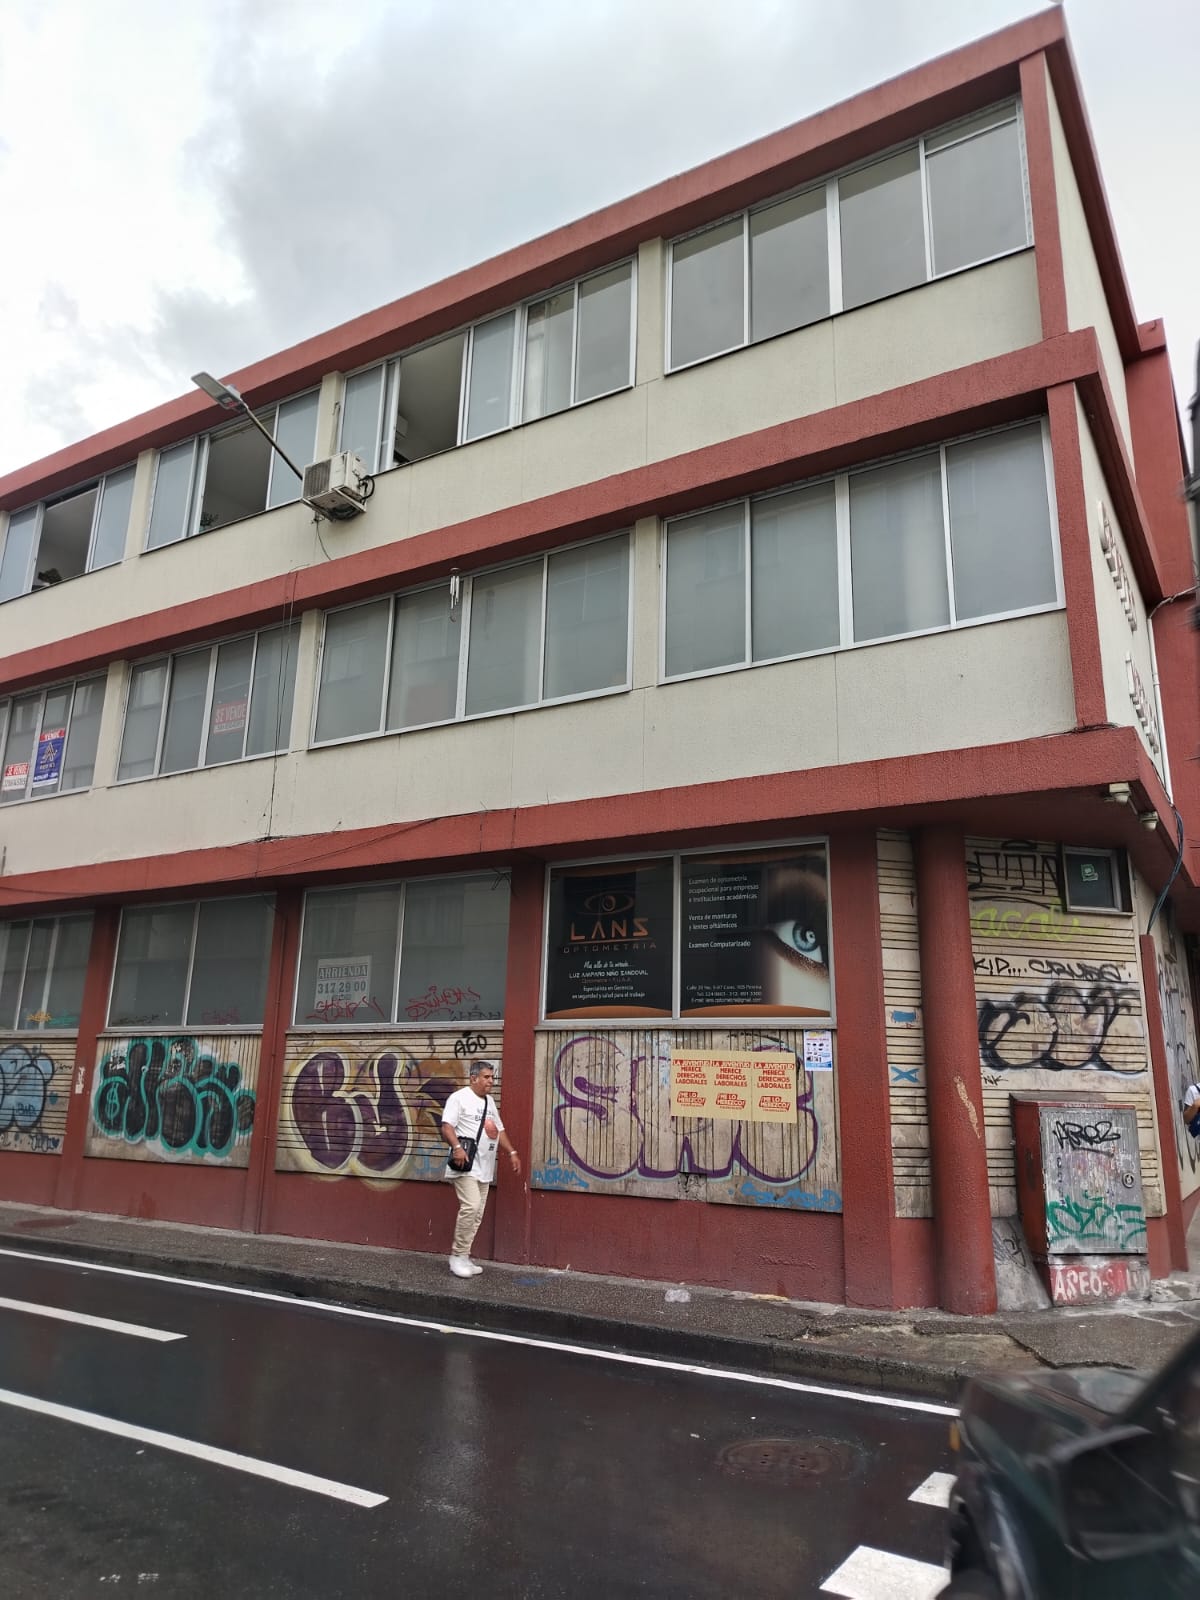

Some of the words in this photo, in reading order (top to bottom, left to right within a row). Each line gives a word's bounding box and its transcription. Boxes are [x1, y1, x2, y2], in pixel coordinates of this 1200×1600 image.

[215, 708, 226, 724] SE
[225, 704, 247, 722] VENDE
[570, 917, 649, 941] LANS
[710, 940, 751, 950] Computarizado
[319, 965, 369, 980] ARRIENDA
[317, 982, 336, 994] 317
